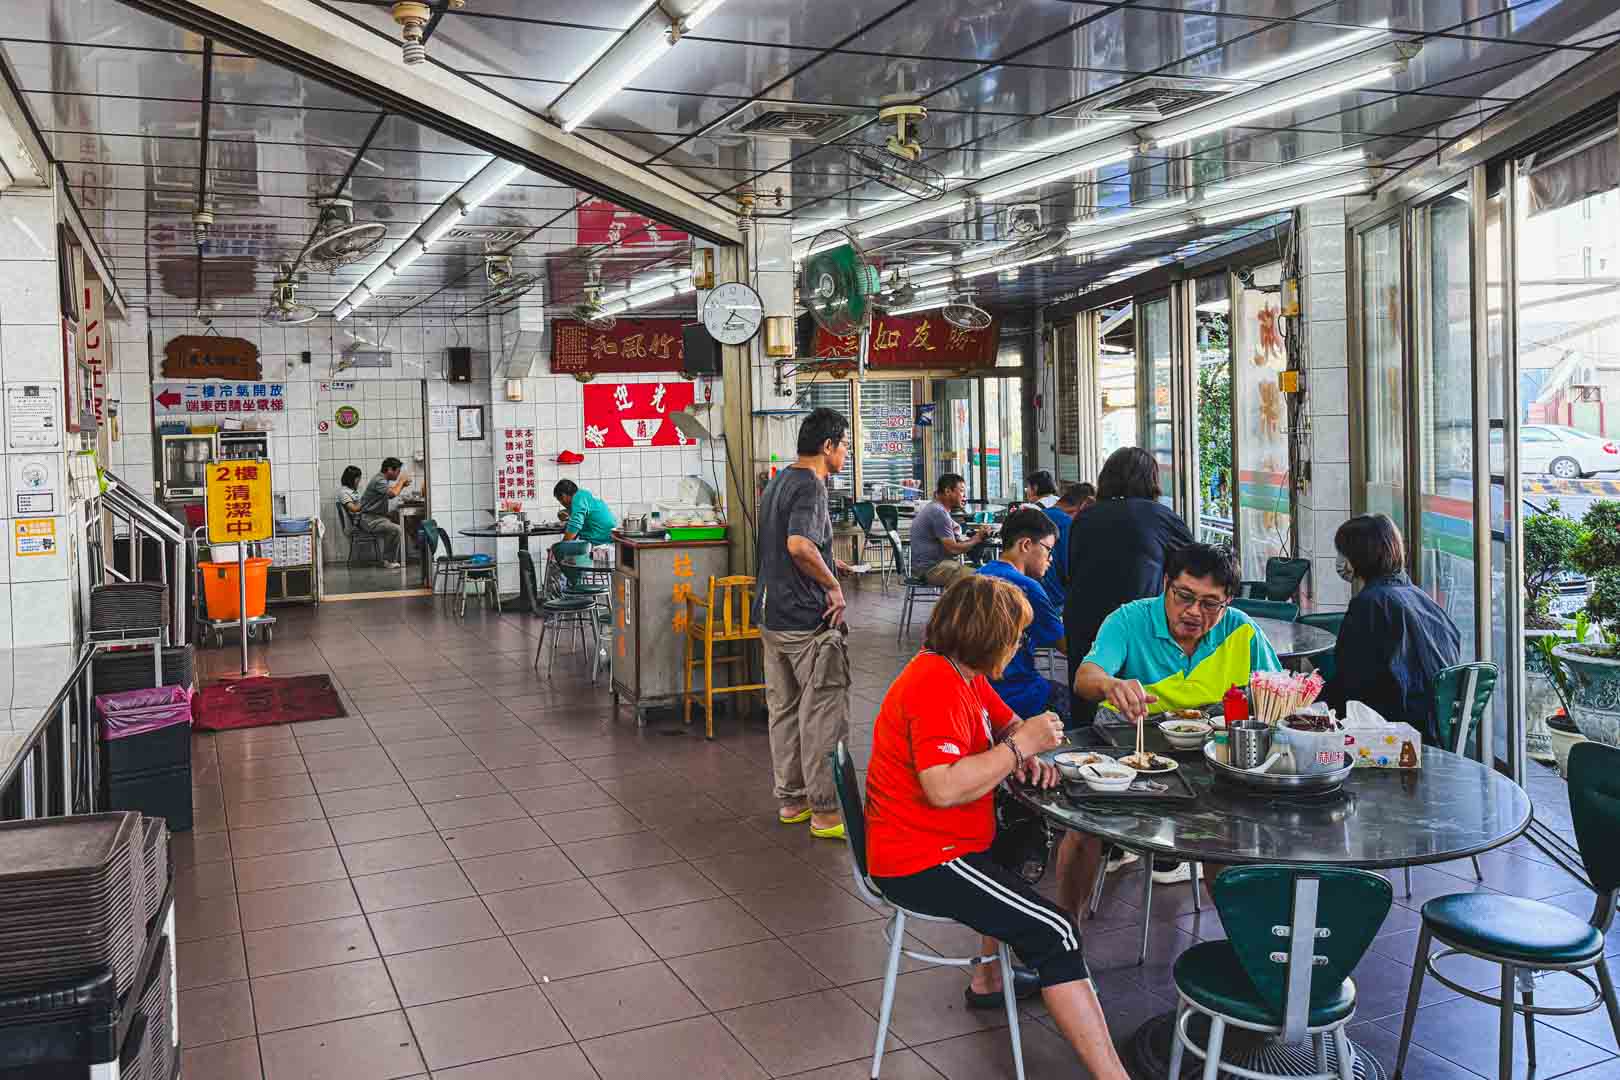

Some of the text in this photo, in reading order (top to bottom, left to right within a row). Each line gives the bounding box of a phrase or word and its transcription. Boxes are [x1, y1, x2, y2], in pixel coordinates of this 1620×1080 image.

[184, 384, 283, 397] 二樓冷氣開放
[185, 399, 283, 412] 端東西請坐電梯
[216, 466, 257, 481] 2樓
[224, 485, 252, 536] 清潔中
